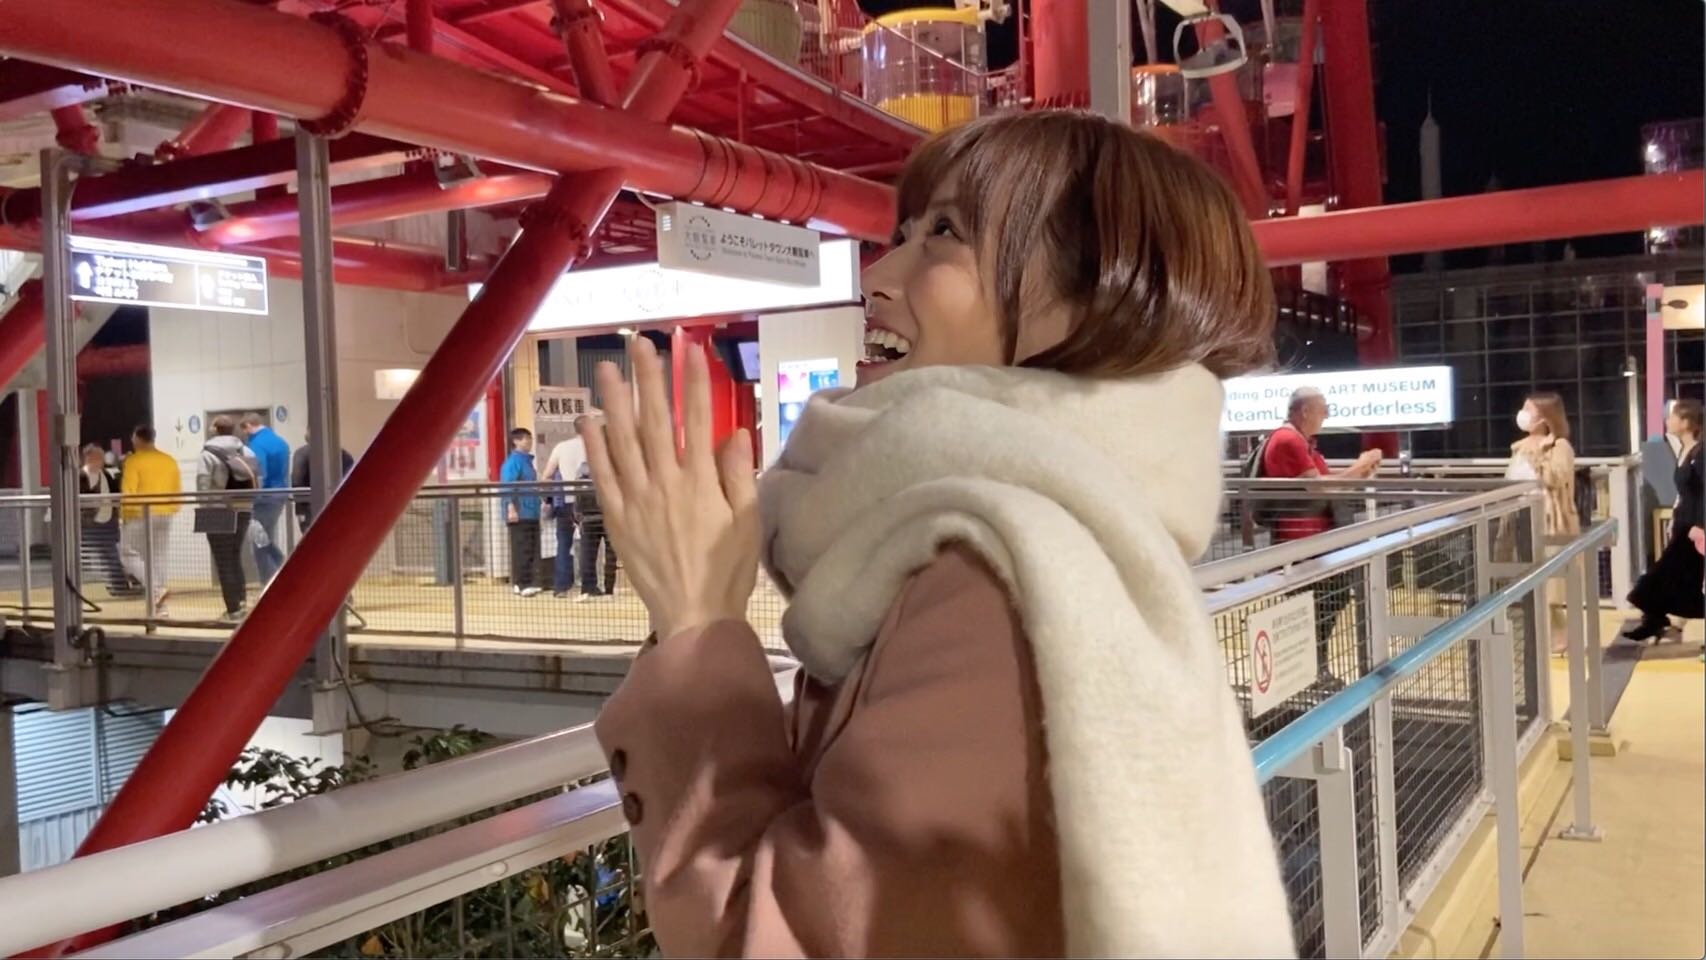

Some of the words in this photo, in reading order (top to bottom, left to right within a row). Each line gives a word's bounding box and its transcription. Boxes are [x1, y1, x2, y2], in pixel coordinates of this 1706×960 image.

[1328, 383, 1358, 395] ART
[1362, 379, 1436, 394] MUSEUM
[535, 397, 585, 415] 大観覧車
[1227, 405, 1286, 422] teamL
[1327, 399, 1438, 418] Borderless
